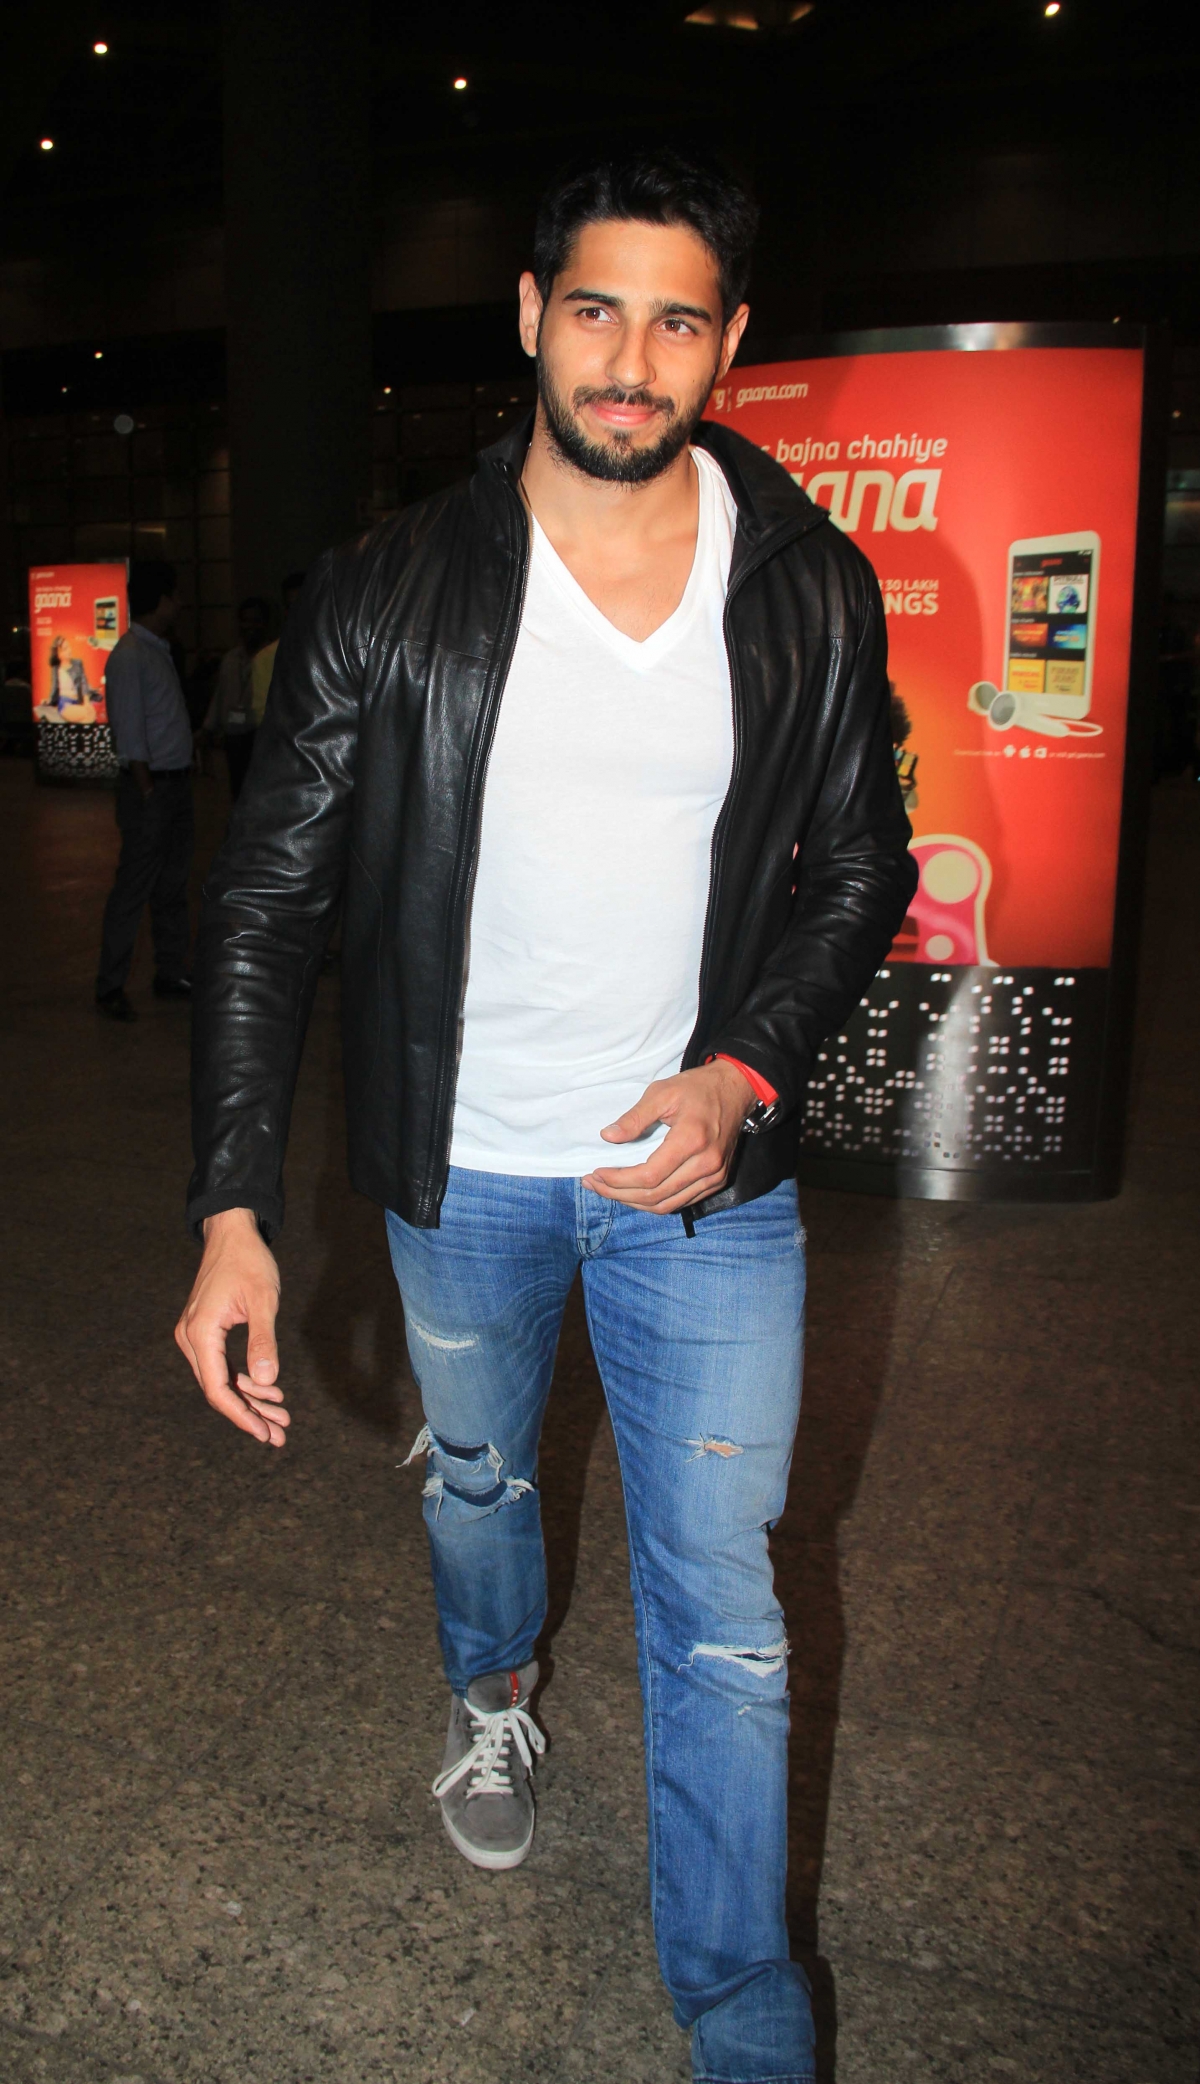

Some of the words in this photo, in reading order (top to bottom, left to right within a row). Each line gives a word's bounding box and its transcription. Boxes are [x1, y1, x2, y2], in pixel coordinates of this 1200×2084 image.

[737, 384, 808, 408] gaana.com
[775, 438, 840, 466] bajna
[848, 433, 948, 463] chahiye
[790, 469, 942, 532] ana
[885, 579, 902, 591] 30
[904, 579, 939, 591] LAKH
[884, 592, 939, 615] NGS
